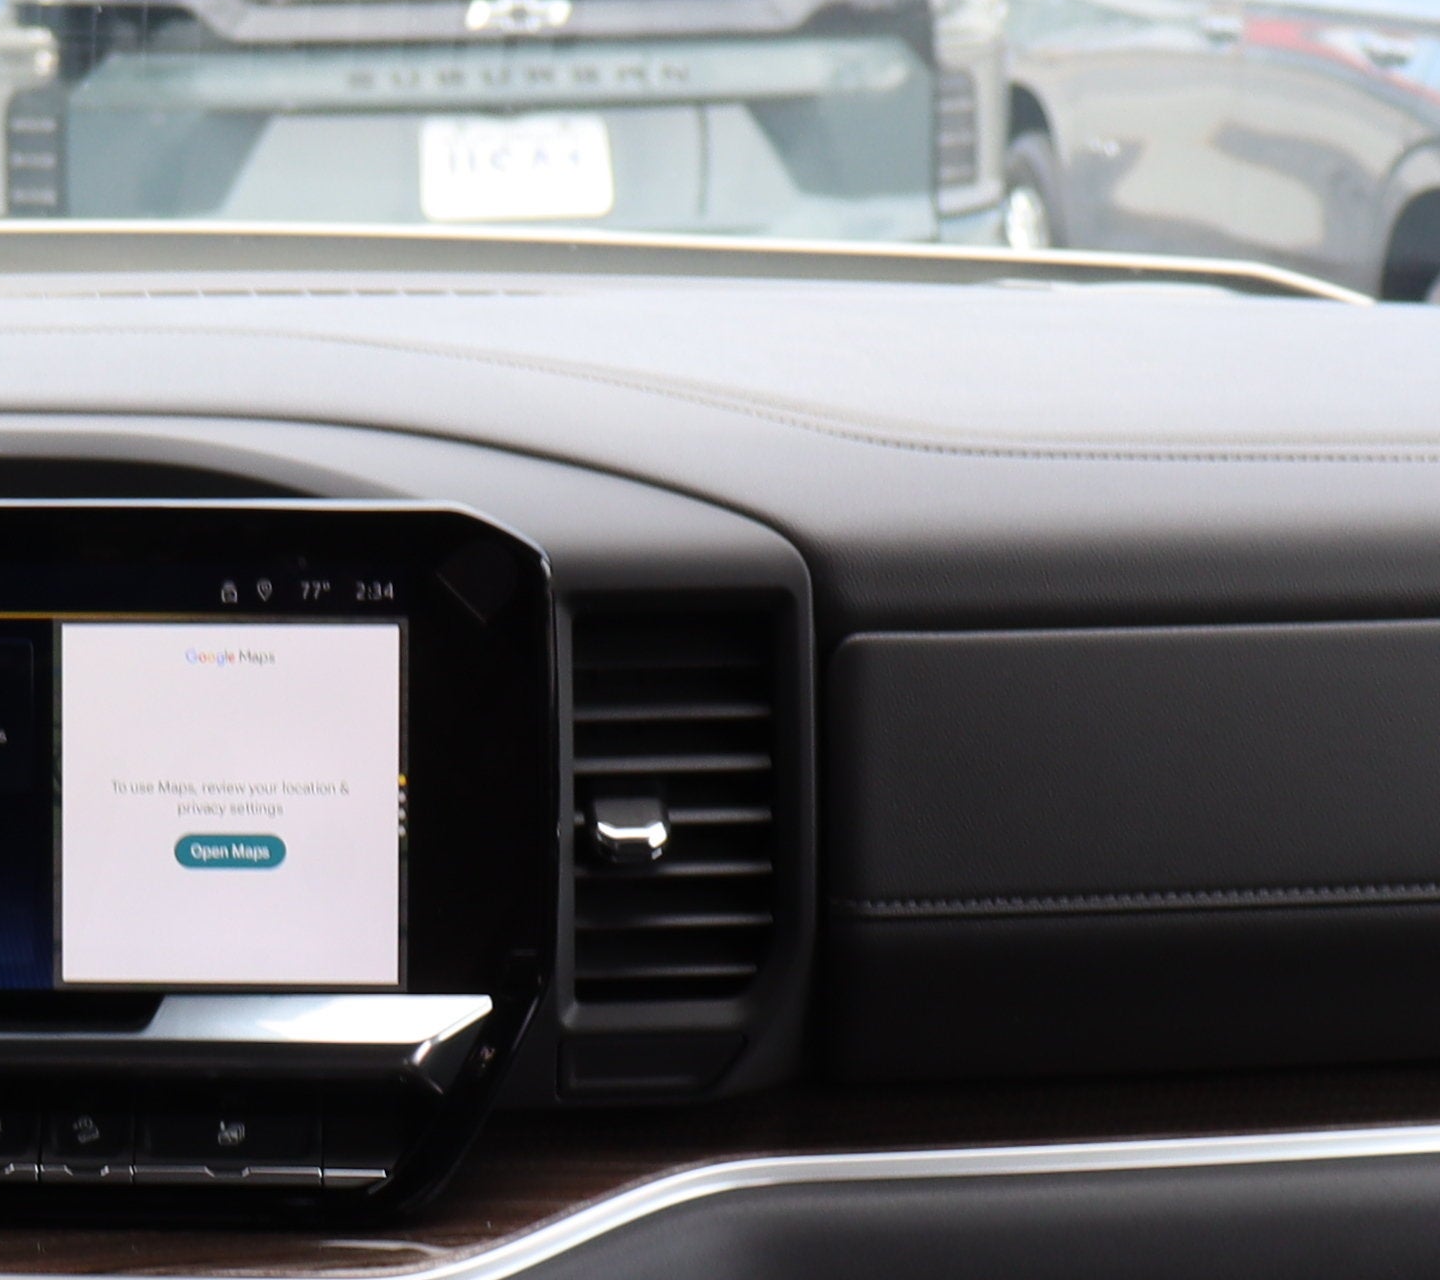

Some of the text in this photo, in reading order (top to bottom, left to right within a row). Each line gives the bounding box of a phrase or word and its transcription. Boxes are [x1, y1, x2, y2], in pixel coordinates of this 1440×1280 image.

[355, 581, 394, 600] 2:34
[185, 649, 275, 666] Google Maps
[112, 780, 127, 794] To
[131, 782, 154, 794] use
[202, 780, 245, 794] review
[248, 782, 277, 798] your
[282, 780, 335, 794] location
[177, 802, 283, 817] privacy settings
[190, 843, 270, 862] Open Maps
